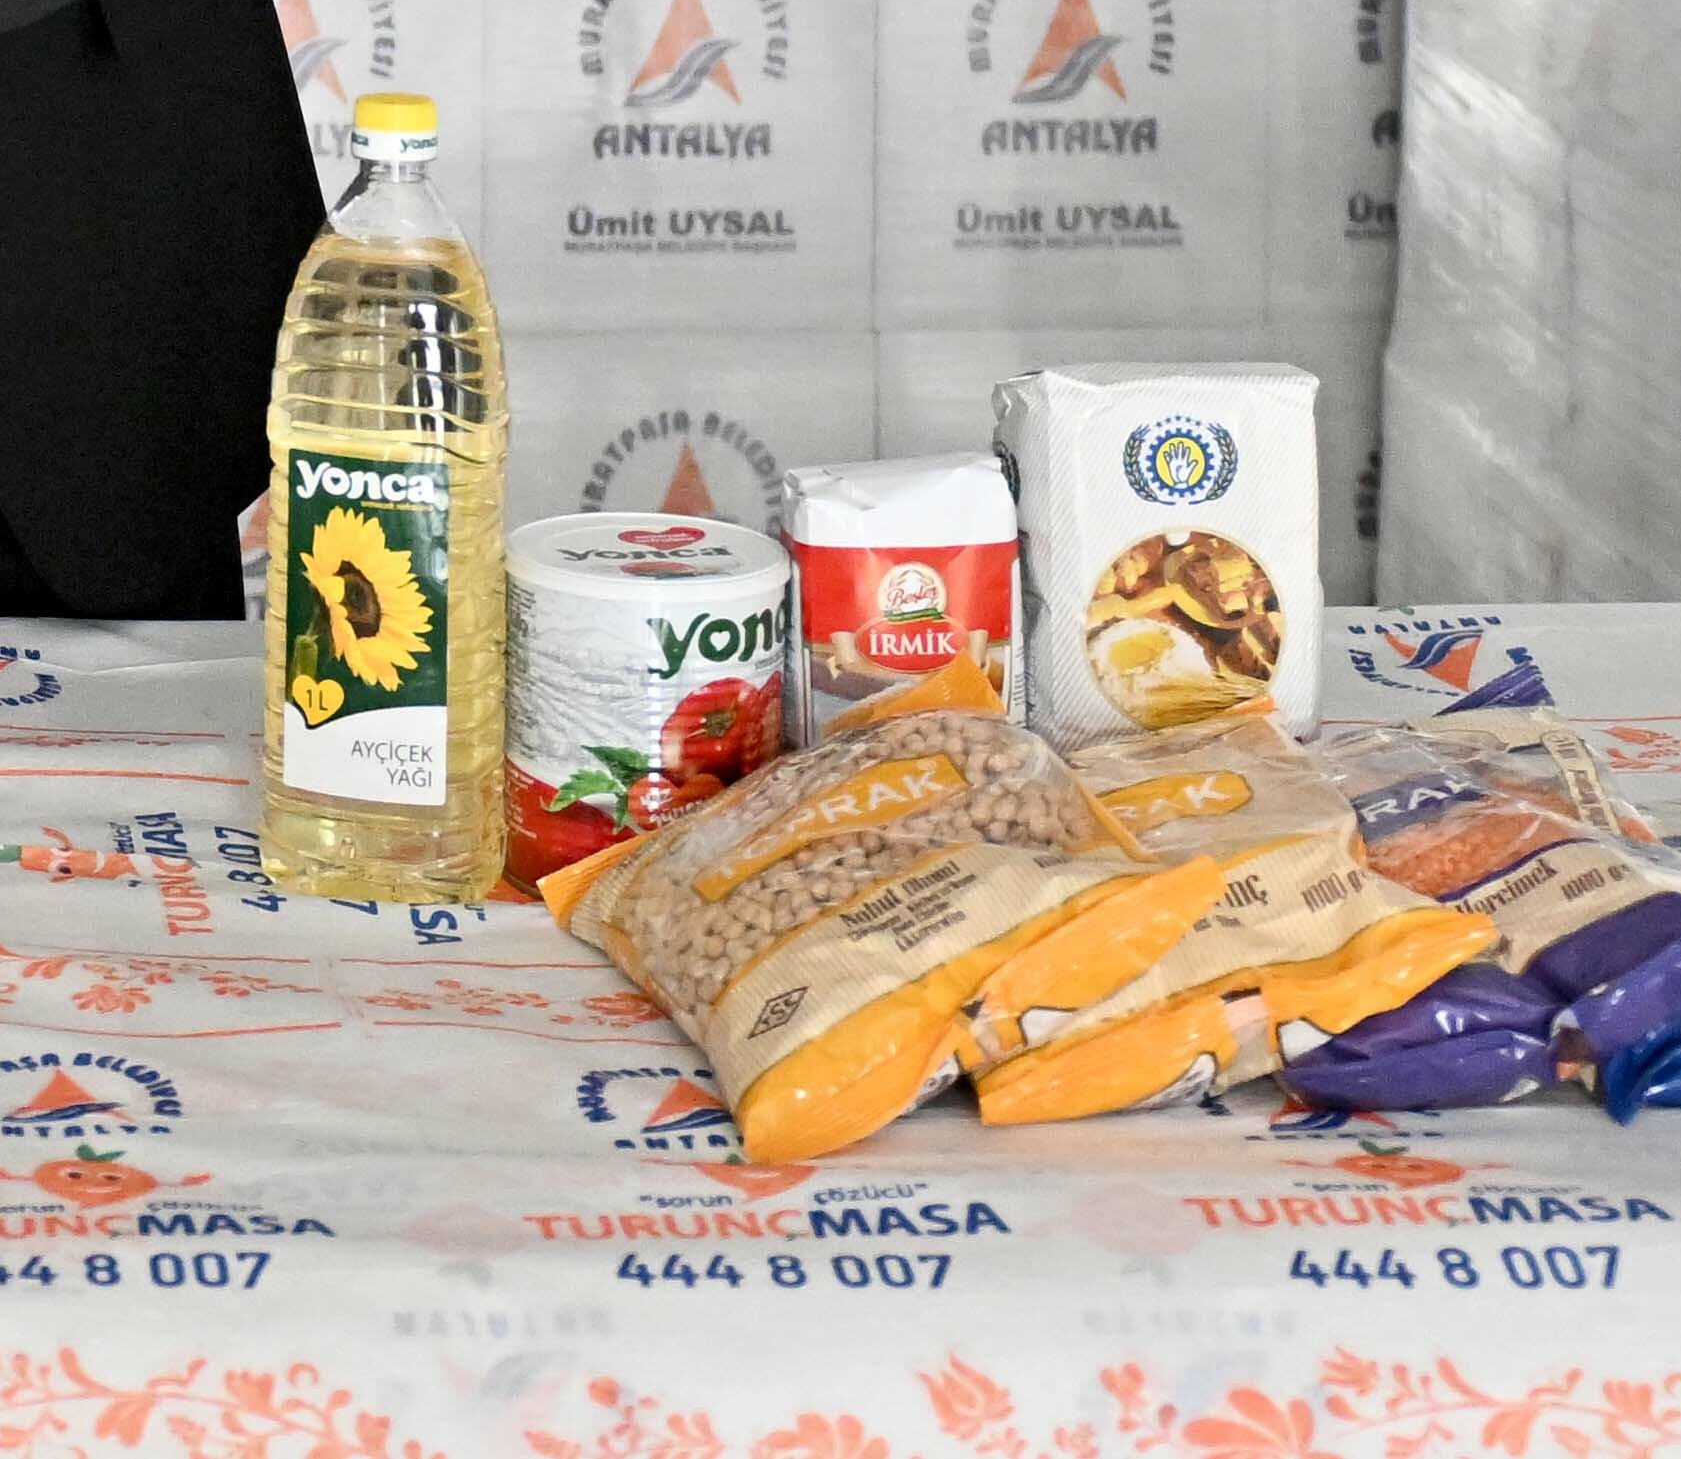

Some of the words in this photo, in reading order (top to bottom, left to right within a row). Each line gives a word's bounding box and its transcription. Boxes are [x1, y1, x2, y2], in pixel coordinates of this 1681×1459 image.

[594, 122, 771, 160] ANTALYA
[982, 117, 1157, 157] ANTALYA
[569, 204, 656, 237] Ümit
[670, 210, 794, 237] UYSAL
[957, 200, 1043, 233] Ümit
[1058, 205, 1180, 233] UYSAL
[296, 459, 437, 502] yonca
[557, 544, 734, 562] yonca
[869, 628, 957, 657] İRMİK
[350, 738, 433, 765] AYÇİÇEK
[386, 768, 432, 789] YAĞI
[82, 1252, 122, 1288] 8
[147, 1250, 273, 1289] 007
[615, 1252, 745, 1290] 444
[767, 1252, 809, 1290] 8
[830, 1252, 954, 1289] 007
[1289, 1247, 1418, 1290] 444
[1435, 1246, 1481, 1290] 8
[1499, 1244, 1621, 1290] 007
